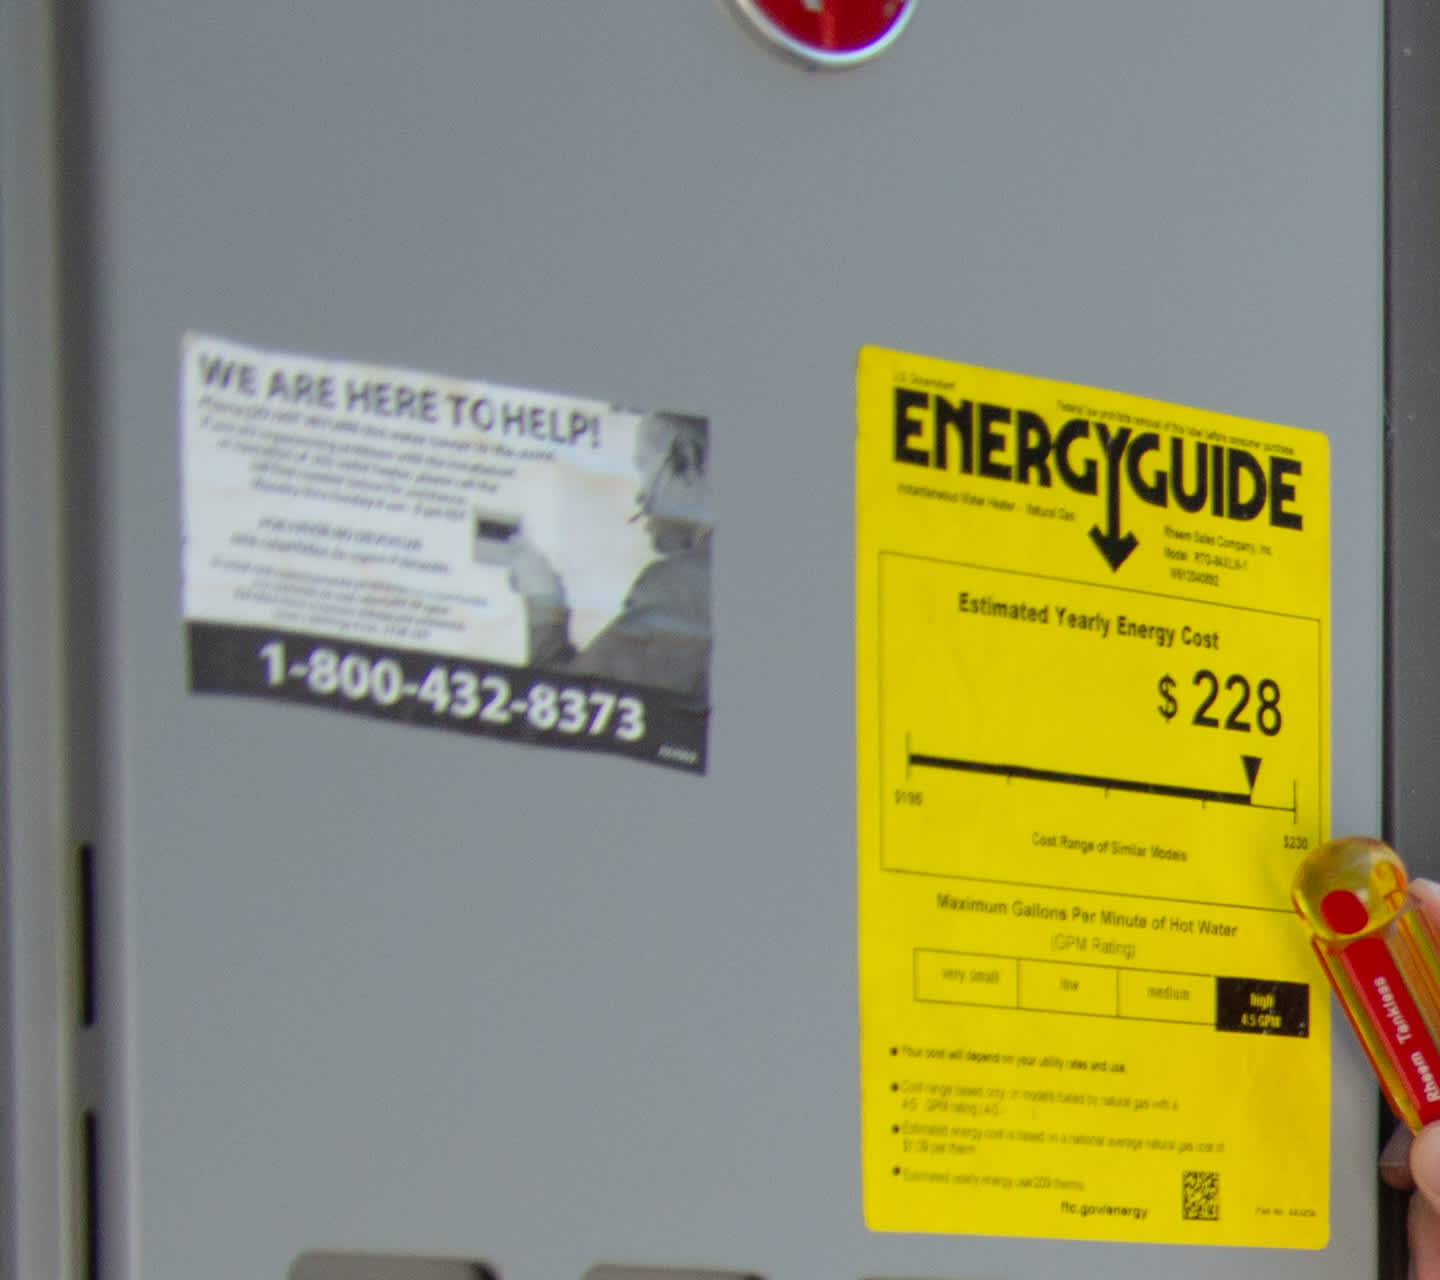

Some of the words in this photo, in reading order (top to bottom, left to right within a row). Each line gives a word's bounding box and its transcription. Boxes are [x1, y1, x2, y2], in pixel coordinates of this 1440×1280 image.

[200, 352, 257, 397] WE
[267, 367, 336, 410] ARE
[345, 378, 438, 424] HERE
[445, 393, 497, 432] TO
[503, 402, 602, 450] HELP!
[892, 386, 1304, 532] ENERGYGUIDE
[958, 591, 1049, 625] Estimated
[1055, 605, 1111, 639] Yearly
[1116, 614, 1176, 650] Energy
[1181, 625, 1220, 652] Cost
[257, 641, 648, 742] 1-800-432-8373
[1192, 668, 1283, 738] 228
[936, 892, 1009, 916] Maximum
[1012, 900, 1068, 922] Gallons
[1071, 906, 1097, 924] Per
[1100, 909, 1148, 930] Minute
[1152, 914, 1166, 932] of
[1170, 915, 1195, 935] Hot
[1198, 919, 1239, 939] Water
[1374, 976, 1412, 1045] Tankless
